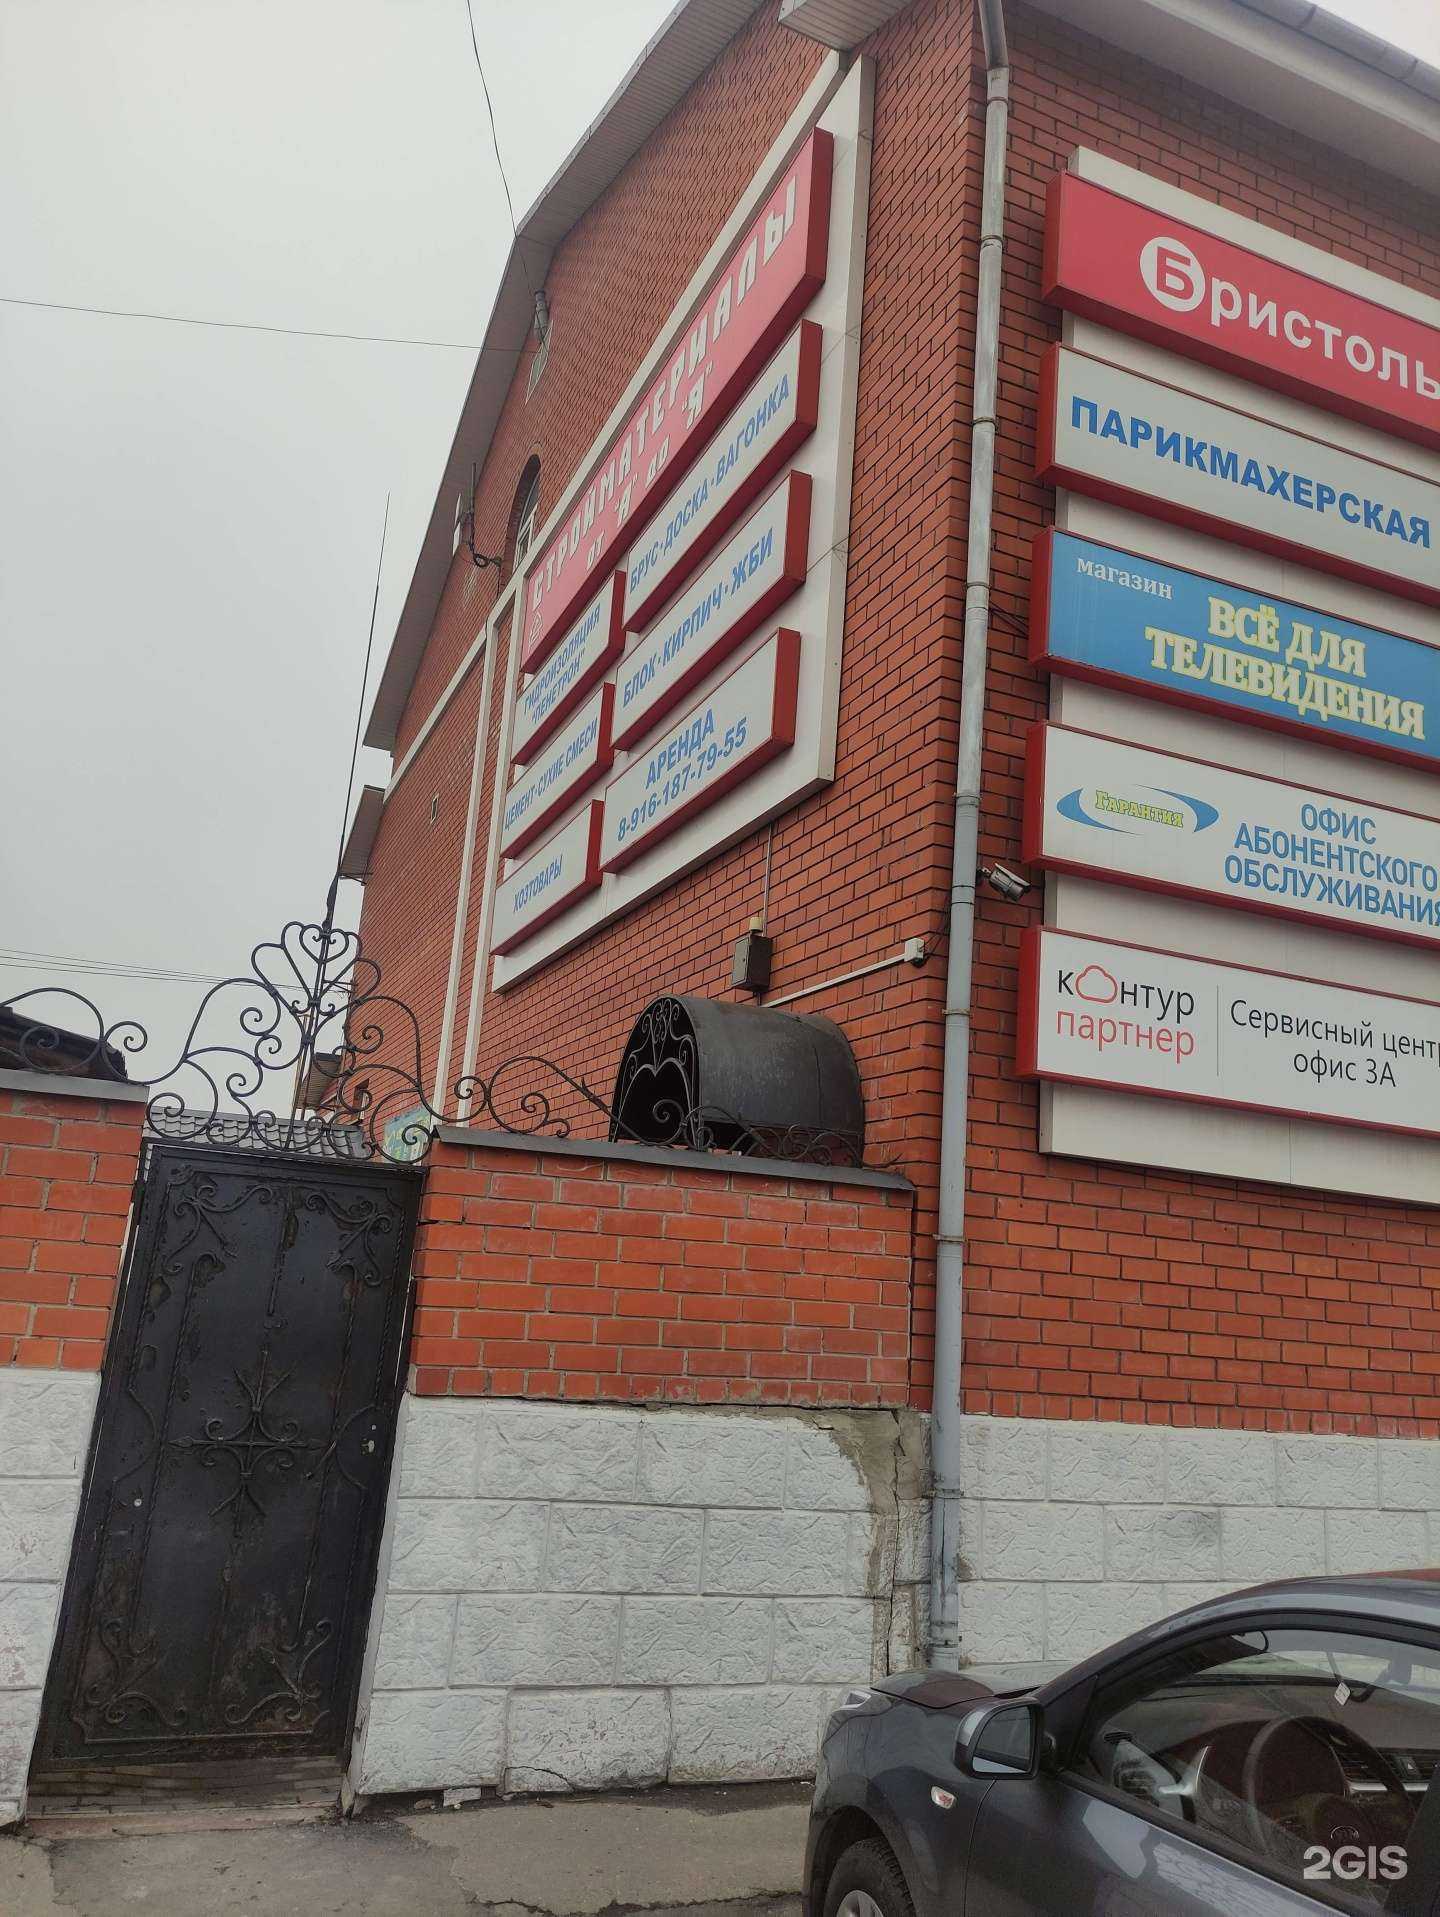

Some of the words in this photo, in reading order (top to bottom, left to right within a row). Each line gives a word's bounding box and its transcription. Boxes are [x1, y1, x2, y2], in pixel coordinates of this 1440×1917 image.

[1140, 237, 1440, 400] Бристоль
[533, 176, 797, 611] СТРОЙМАТЕРИАЛЫ
[1071, 395, 1431, 550] ПАРИКМАХЕРСКАЯ
[1077, 557, 1174, 600] магазин
[523, 602, 601, 714] ГИДРОИЗОЛЯЦИЯ
[1208, 596, 1281, 652] ВСЁ
[1284, 621, 1367, 678] ДЛЯ
[1144, 626, 1426, 741] ТЕЛЕВИДЕНИЯ
[565, 716, 598, 767] СМЕСИ
[617, 716, 747, 841] 8-916-187-79-55
[645, 708, 715, 790] АРЕНДА
[1234, 822, 1438, 892] АБОНЕНТСКОГО
[1301, 803, 1377, 845] ОФИС
[513, 853, 563, 913] ХОЗТОВАРЫ
[1057, 1010, 1195, 1064] партнер
[1230, 999, 1374, 1048] Сервисный
[1383, 1032, 1440, 1068] цент
[1293, 1049, 1357, 1083] офис
